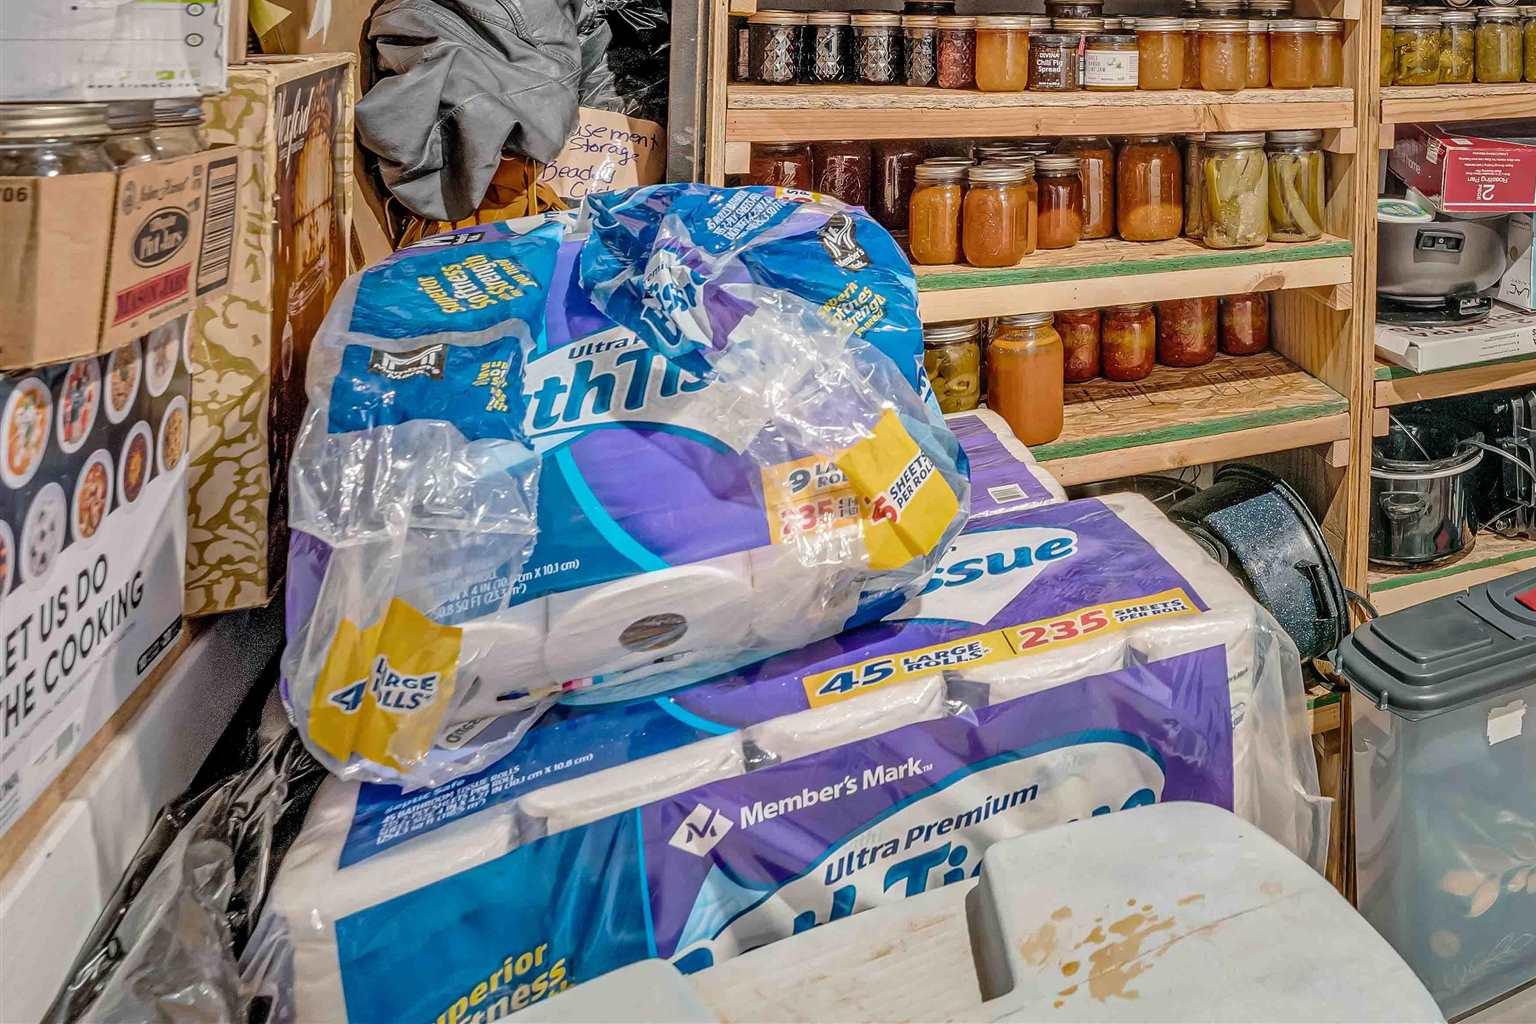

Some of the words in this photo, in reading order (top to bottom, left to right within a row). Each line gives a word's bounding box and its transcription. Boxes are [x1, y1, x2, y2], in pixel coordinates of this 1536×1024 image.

[569, 137, 639, 166] Storage
[567, 337, 631, 360] Ultra
[896, 486, 914, 509] PER
[909, 460, 937, 494] ROLL
[2, 614, 34, 674] ET
[39, 585, 69, 644] US
[77, 553, 108, 613] DO
[1113, 598, 1183, 617] SHEETS
[1119, 612, 1144, 623] PER
[1151, 605, 1188, 619] ROLL
[43, 569, 145, 694] COOKING
[1018, 609, 1109, 650] 235
[903, 642, 981, 666] LARGE
[906, 650, 989, 673] ROLLS
[330, 678, 368, 712] 4
[819, 661, 894, 696] 45
[740, 775, 859, 830] Member's
[824, 836, 901, 887] Ultra
[903, 783, 1039, 851] Premium
